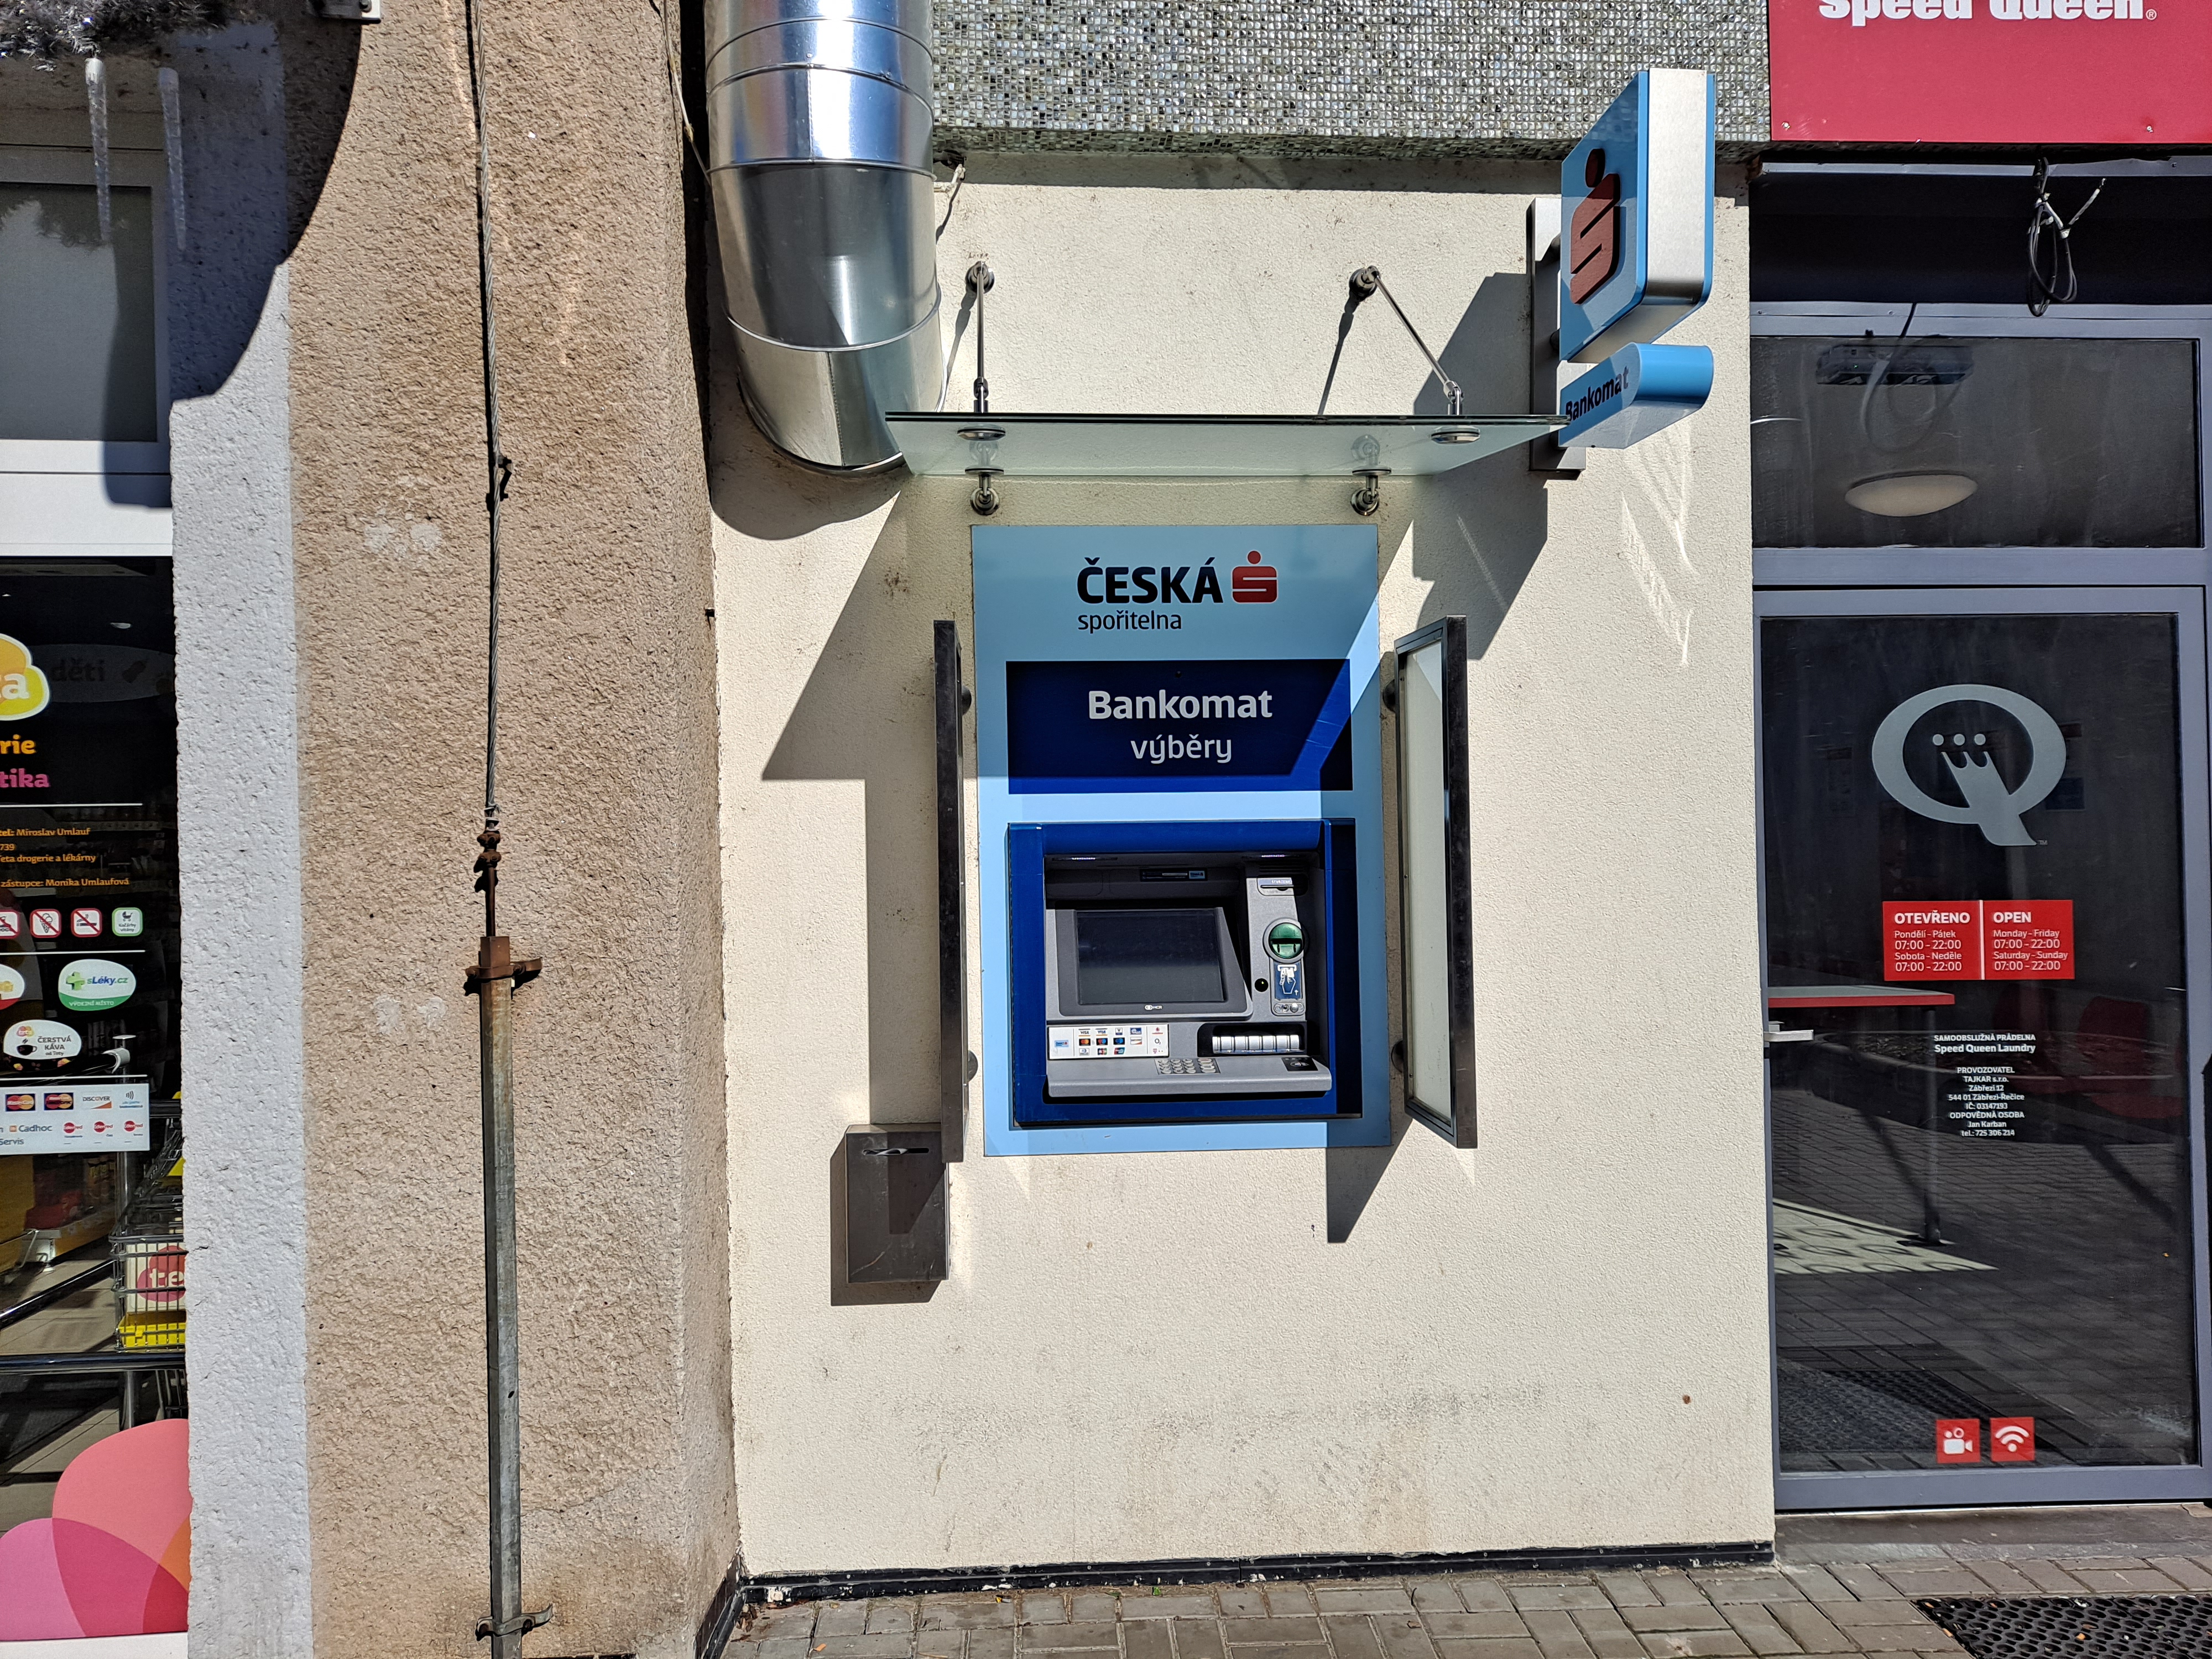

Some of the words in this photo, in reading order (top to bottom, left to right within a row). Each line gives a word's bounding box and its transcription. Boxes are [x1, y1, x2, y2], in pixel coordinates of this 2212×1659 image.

[1566, 366, 1629, 421] Bankomat
[1077, 557, 1223, 604] ČESKÁ
[1078, 610, 1182, 634] spořitelna
[1088, 689, 1273, 719] Bankomat
[1130, 734, 1232, 764] výběry
[17, 854, 55, 864] drogerie
[62, 854, 96, 863] lékárny
[1, 879, 44, 889] zástupce:
[1895, 910, 1970, 924] OTEVŘENO
[1993, 912, 2032, 923] OPEN
[1895, 930, 1926, 938] Pondělí
[1933, 930, 1956, 938] Pátek
[1994, 930, 2027, 938] Monday
[2034, 929, 2060, 938] Friday
[1895, 940, 1924, 950] 07:00
[1932, 940, 1961, 950] 22:00
[1994, 939, 2023, 948] 07:00
[2031, 939, 2060, 948] 22:00
[1994, 951, 2030, 961] Saturday
[2036, 951, 2068, 960] Sunday
[1896, 962, 1924, 972] 07:00
[1933, 962, 1961, 971] 22:00
[1994, 961, 2023, 970] 07:00
[2031, 961, 2060, 970] 22:00
[87, 976, 128, 985] sLéky.cz
[1934, 1044, 1964, 1054] Speed
[1966, 1044, 1996, 1053] Queen
[1998, 1044, 2036, 1053] Laundry
[1949, 1110, 1997, 1119] ODPOVĚDNÁ
